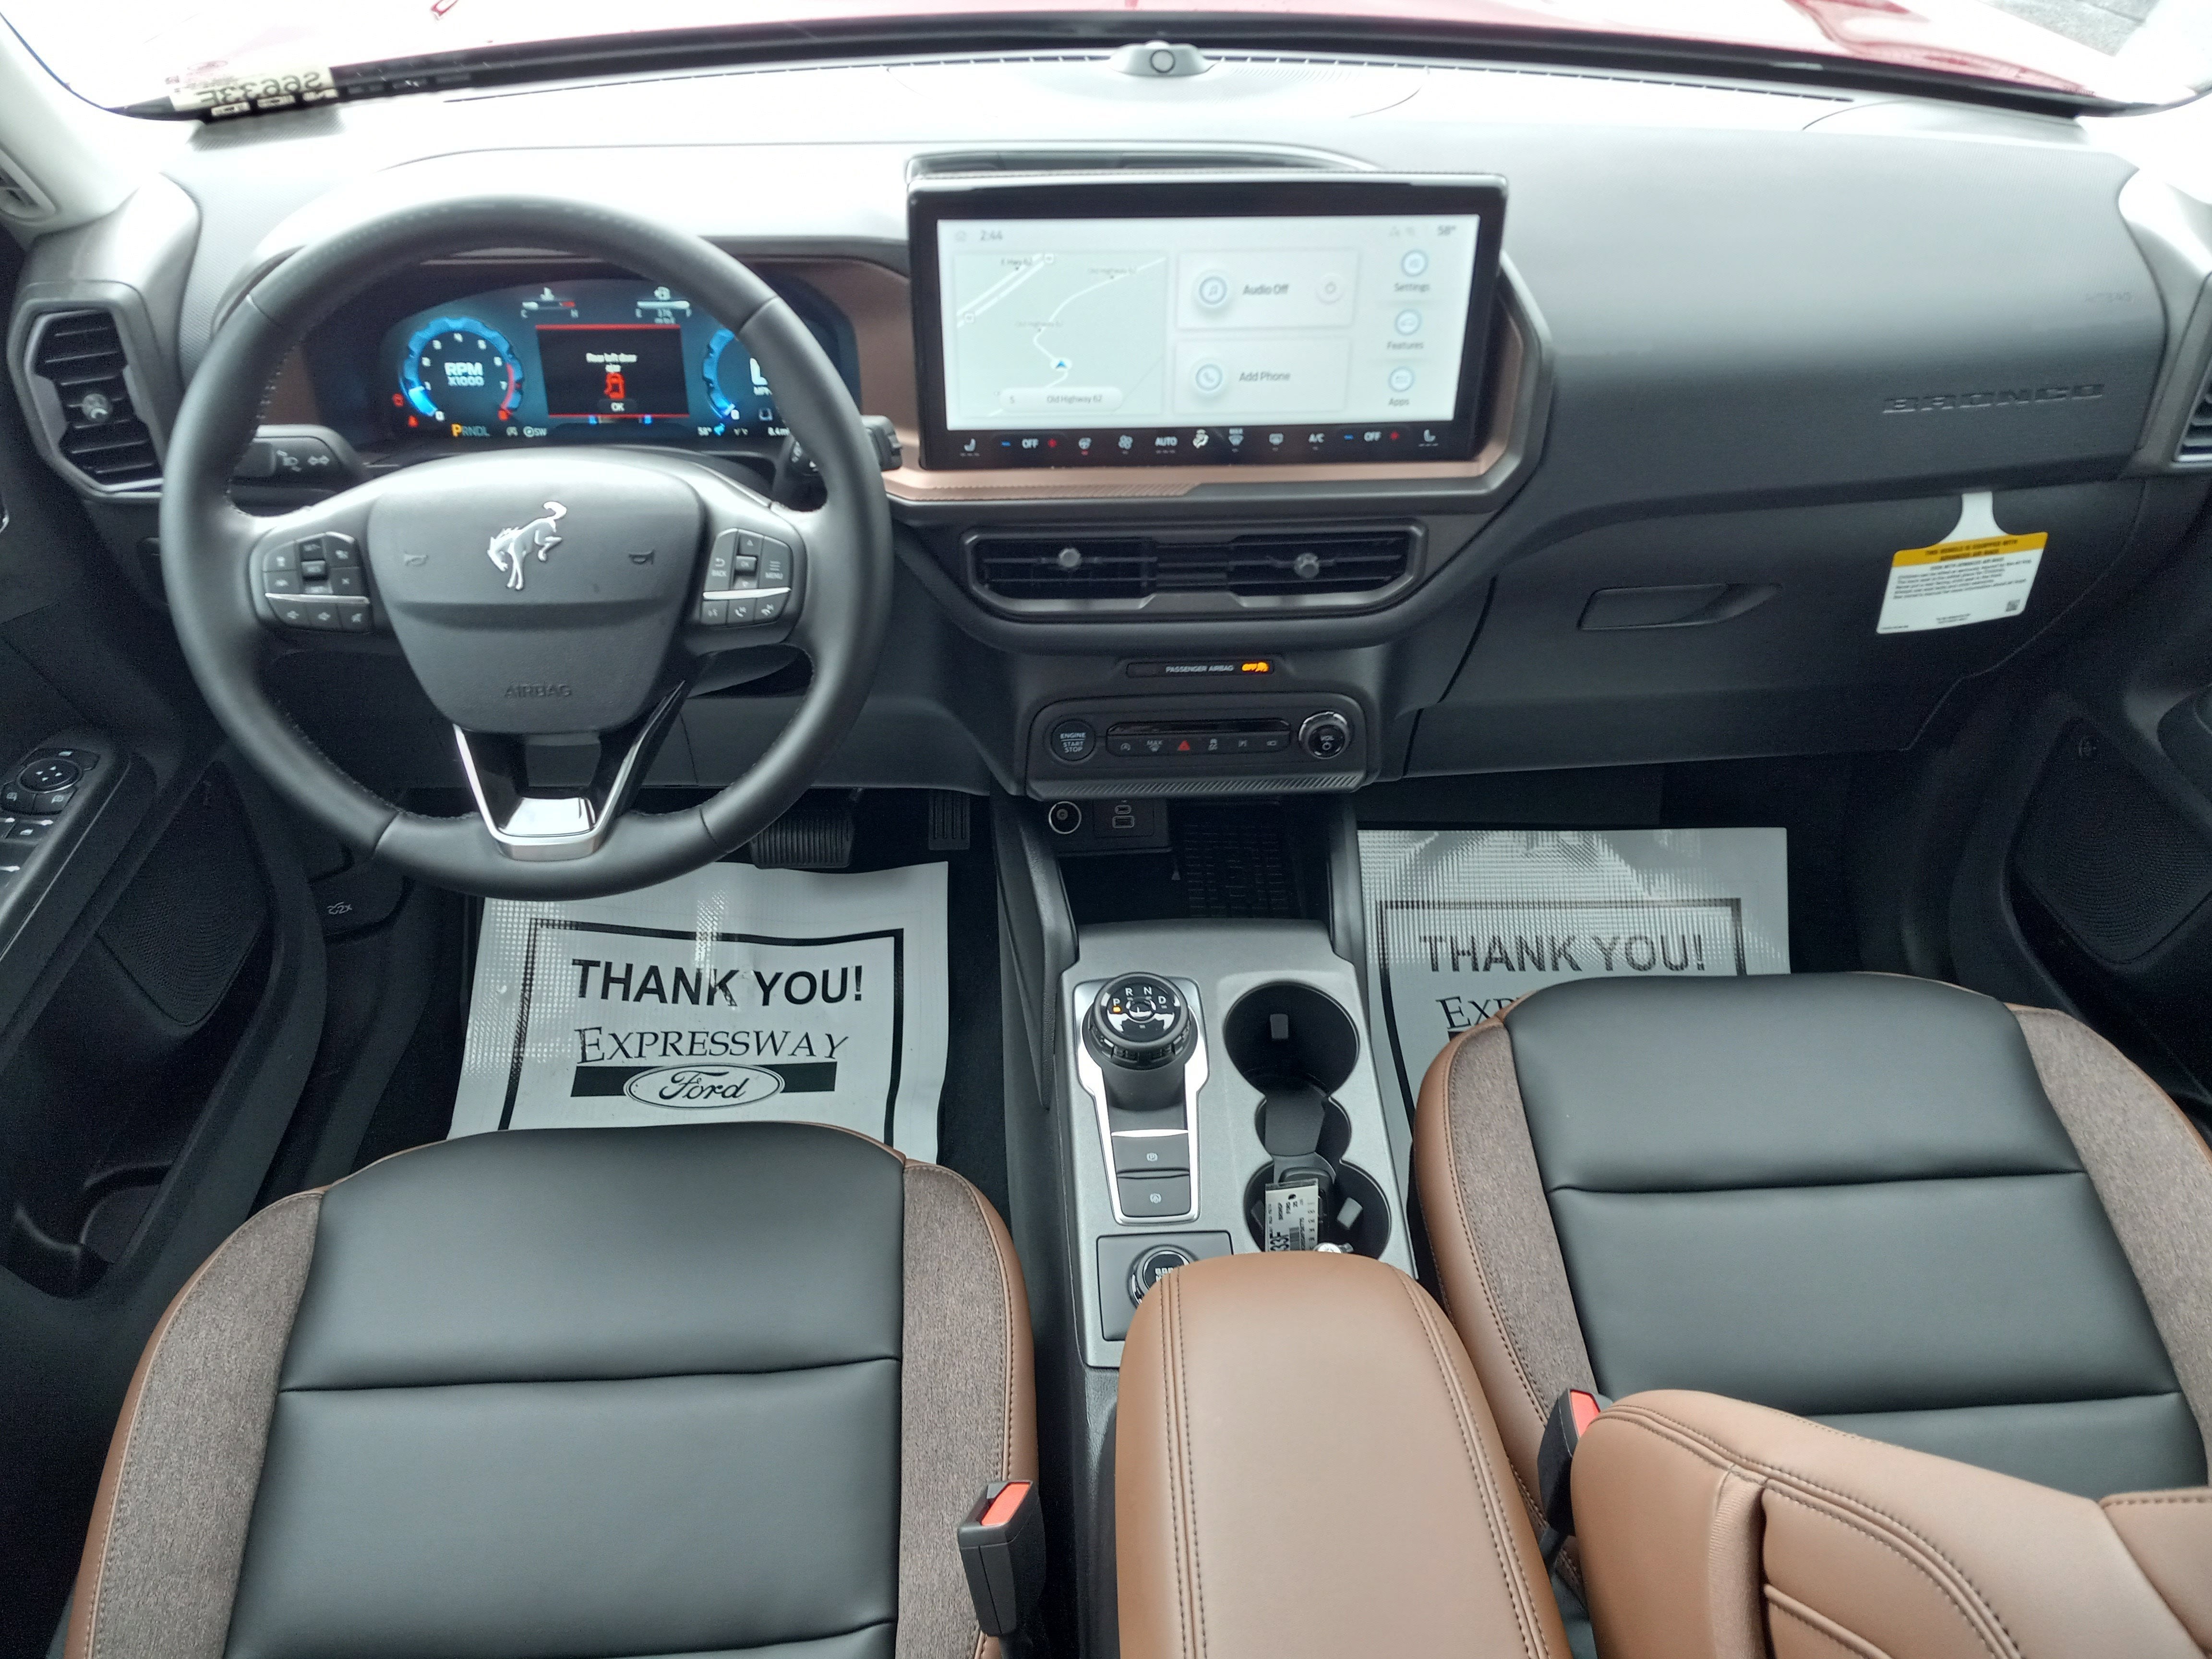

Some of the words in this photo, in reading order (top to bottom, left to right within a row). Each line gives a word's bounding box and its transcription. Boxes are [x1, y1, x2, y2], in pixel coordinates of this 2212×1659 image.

[1242, 284, 1271, 296] Audio
[1273, 283, 1289, 295] Off
[1394, 282, 1430, 292] Settings
[1387, 340, 1424, 350] Features
[445, 362, 483, 376] RPM
[1239, 371, 1256, 382] Add
[1258, 371, 1291, 382] Phone
[1047, 395, 1060, 403] Old
[1061, 395, 1091, 405] Highway
[1388, 397, 1410, 408] Apps
[1882, 384, 2105, 414] BRONCO
[611, 402, 625, 411] OK
[1022, 438, 1039, 449] OFF
[1154, 436, 1178, 447] AUTO
[505, 682, 572, 697] AIRBAG
[1419, 935, 1582, 973] THANK
[1592, 934, 1705, 972] YOU!
[572, 958, 738, 1007] THANK
[753, 964, 863, 1007] YOU!
[1125, 987, 1134, 996] R
[1143, 986, 1152, 995] N
[1113, 998, 1120, 1007] P
[1158, 996, 1166, 1004] D
[658, 1070, 749, 1101] Ford
